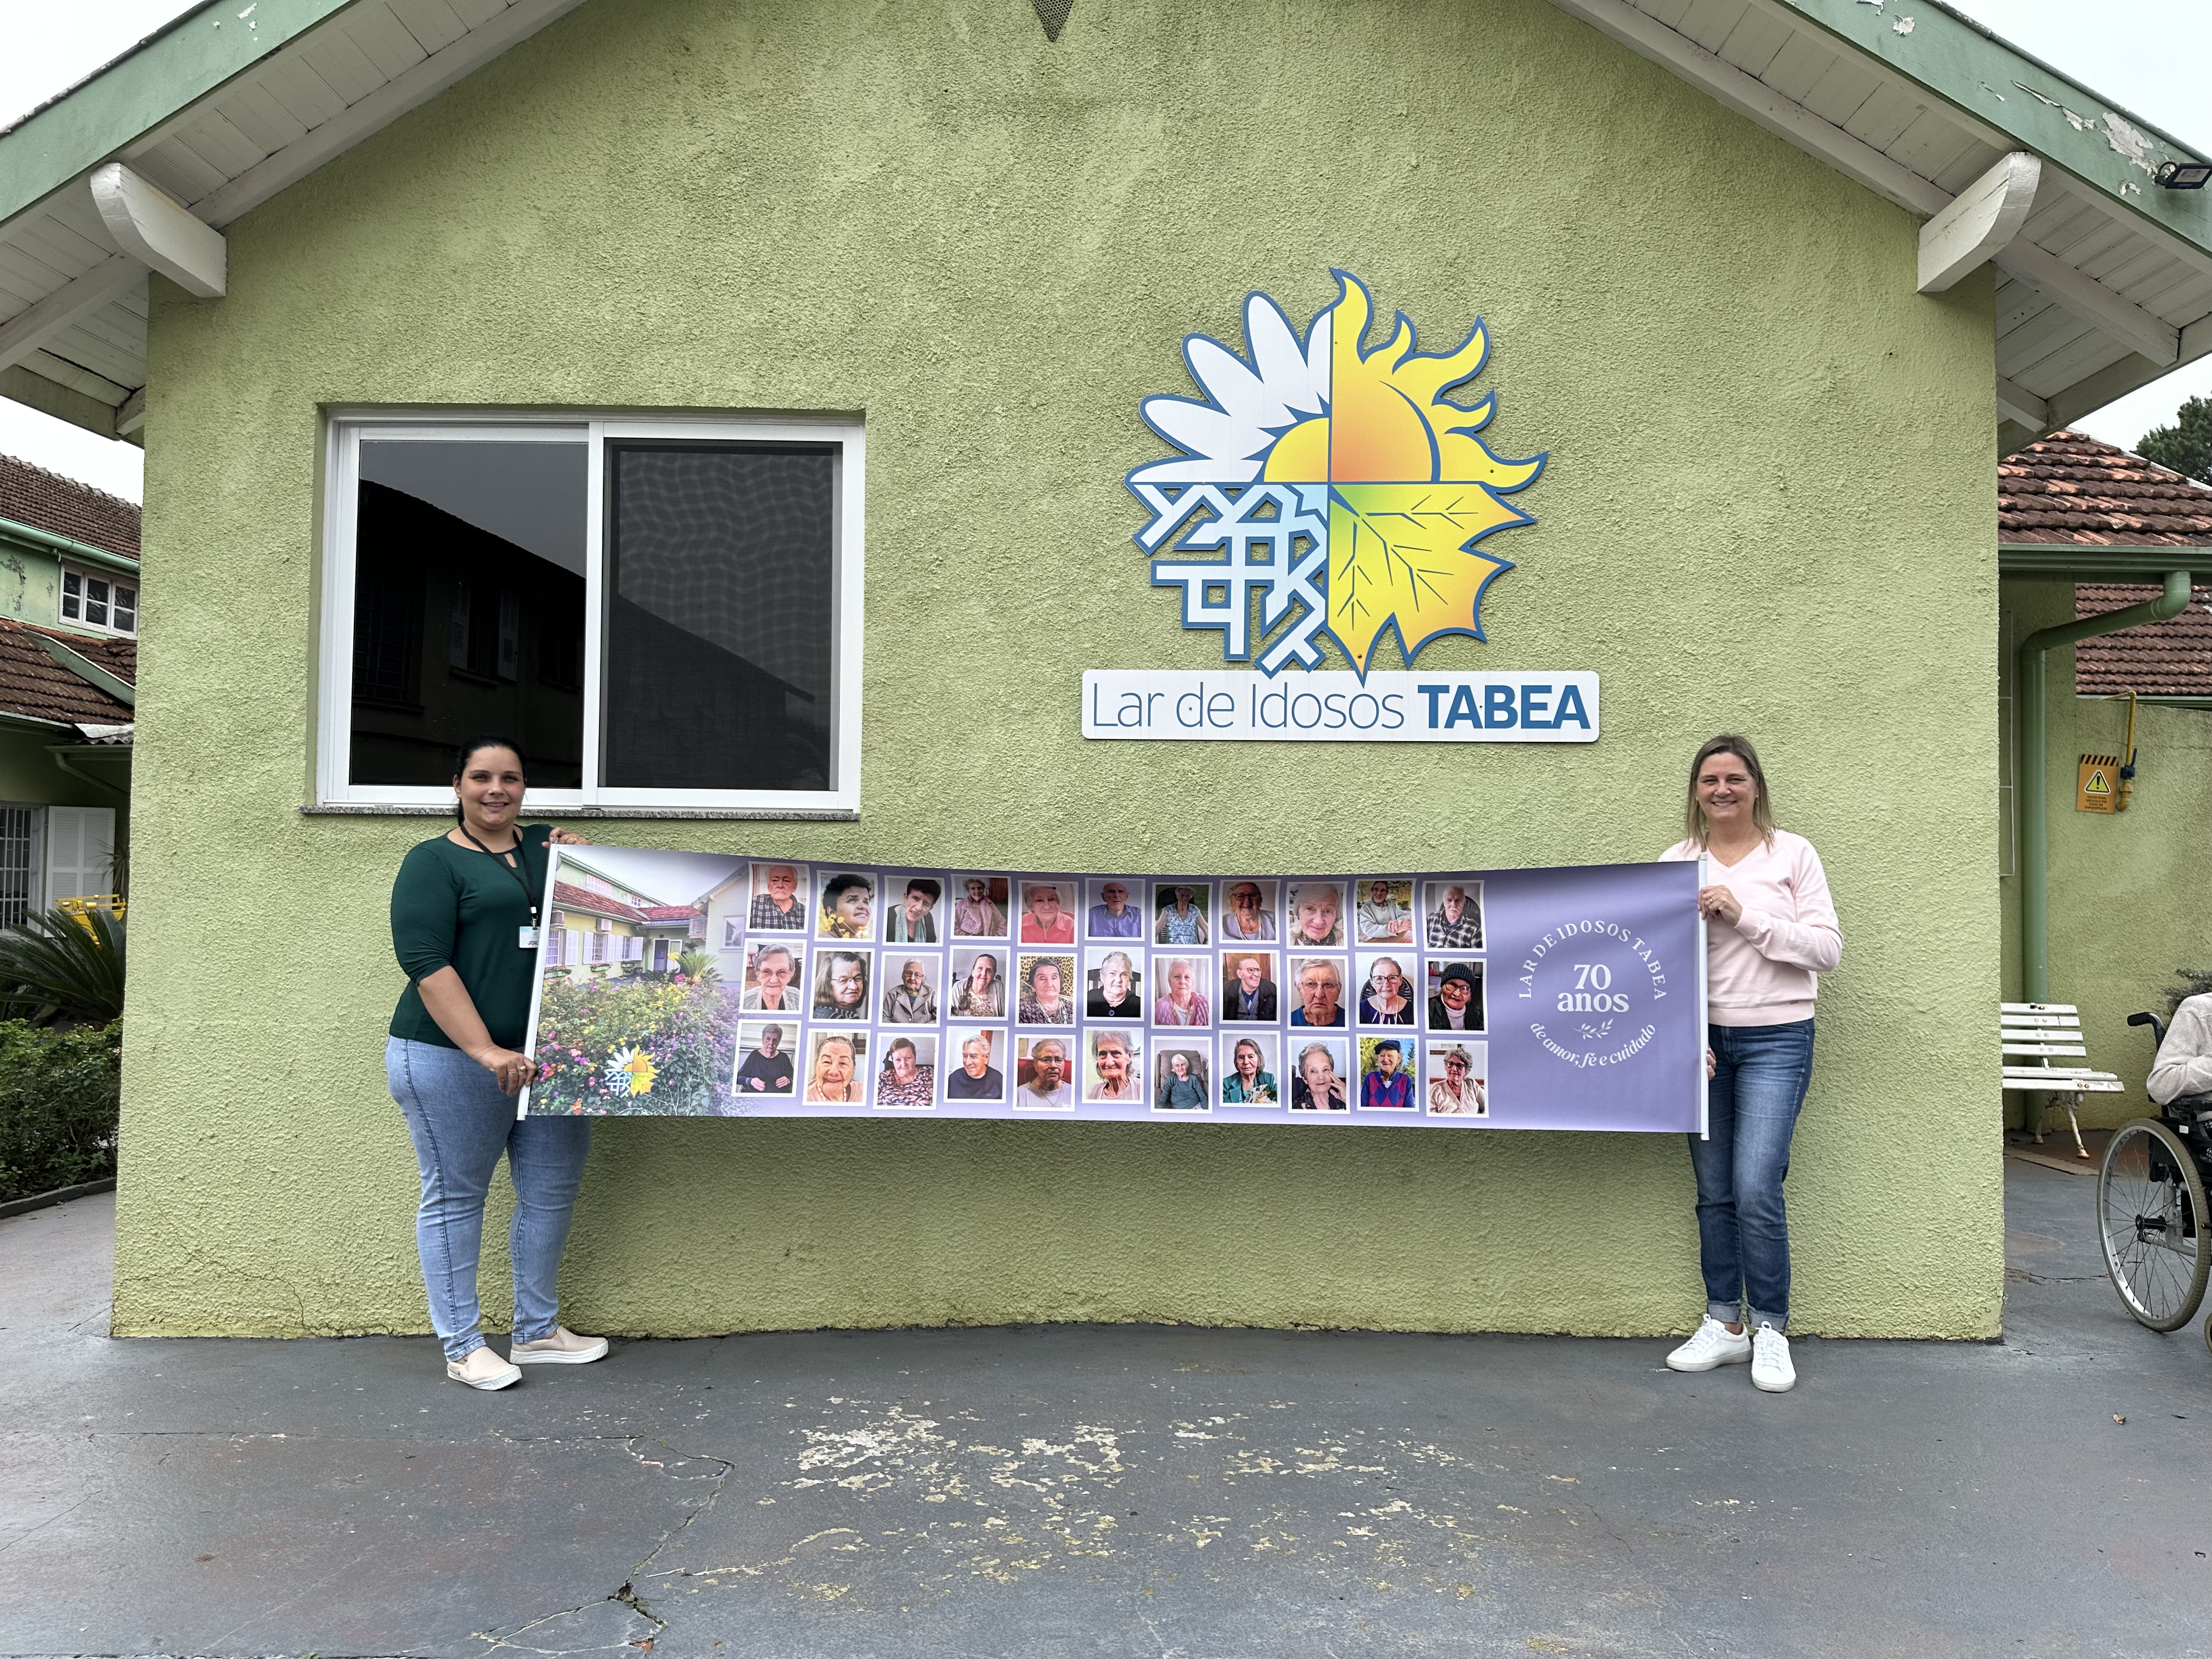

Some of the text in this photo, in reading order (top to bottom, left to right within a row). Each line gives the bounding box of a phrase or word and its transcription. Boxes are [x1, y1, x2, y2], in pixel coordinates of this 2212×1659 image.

[1093, 681, 1592, 730] Lar de Idosos TABEA
[1519, 920, 1667, 1000] LAR DE IDOSOS TABEA
[1573, 964, 1612, 990] 70
[1557, 992, 1630, 1013] anos
[1530, 1023, 1547, 1040] de
[1543, 1039, 1580, 1066] amor,
[1599, 1056, 1608, 1066] e
[1609, 1024, 1656, 1064] cuidado
